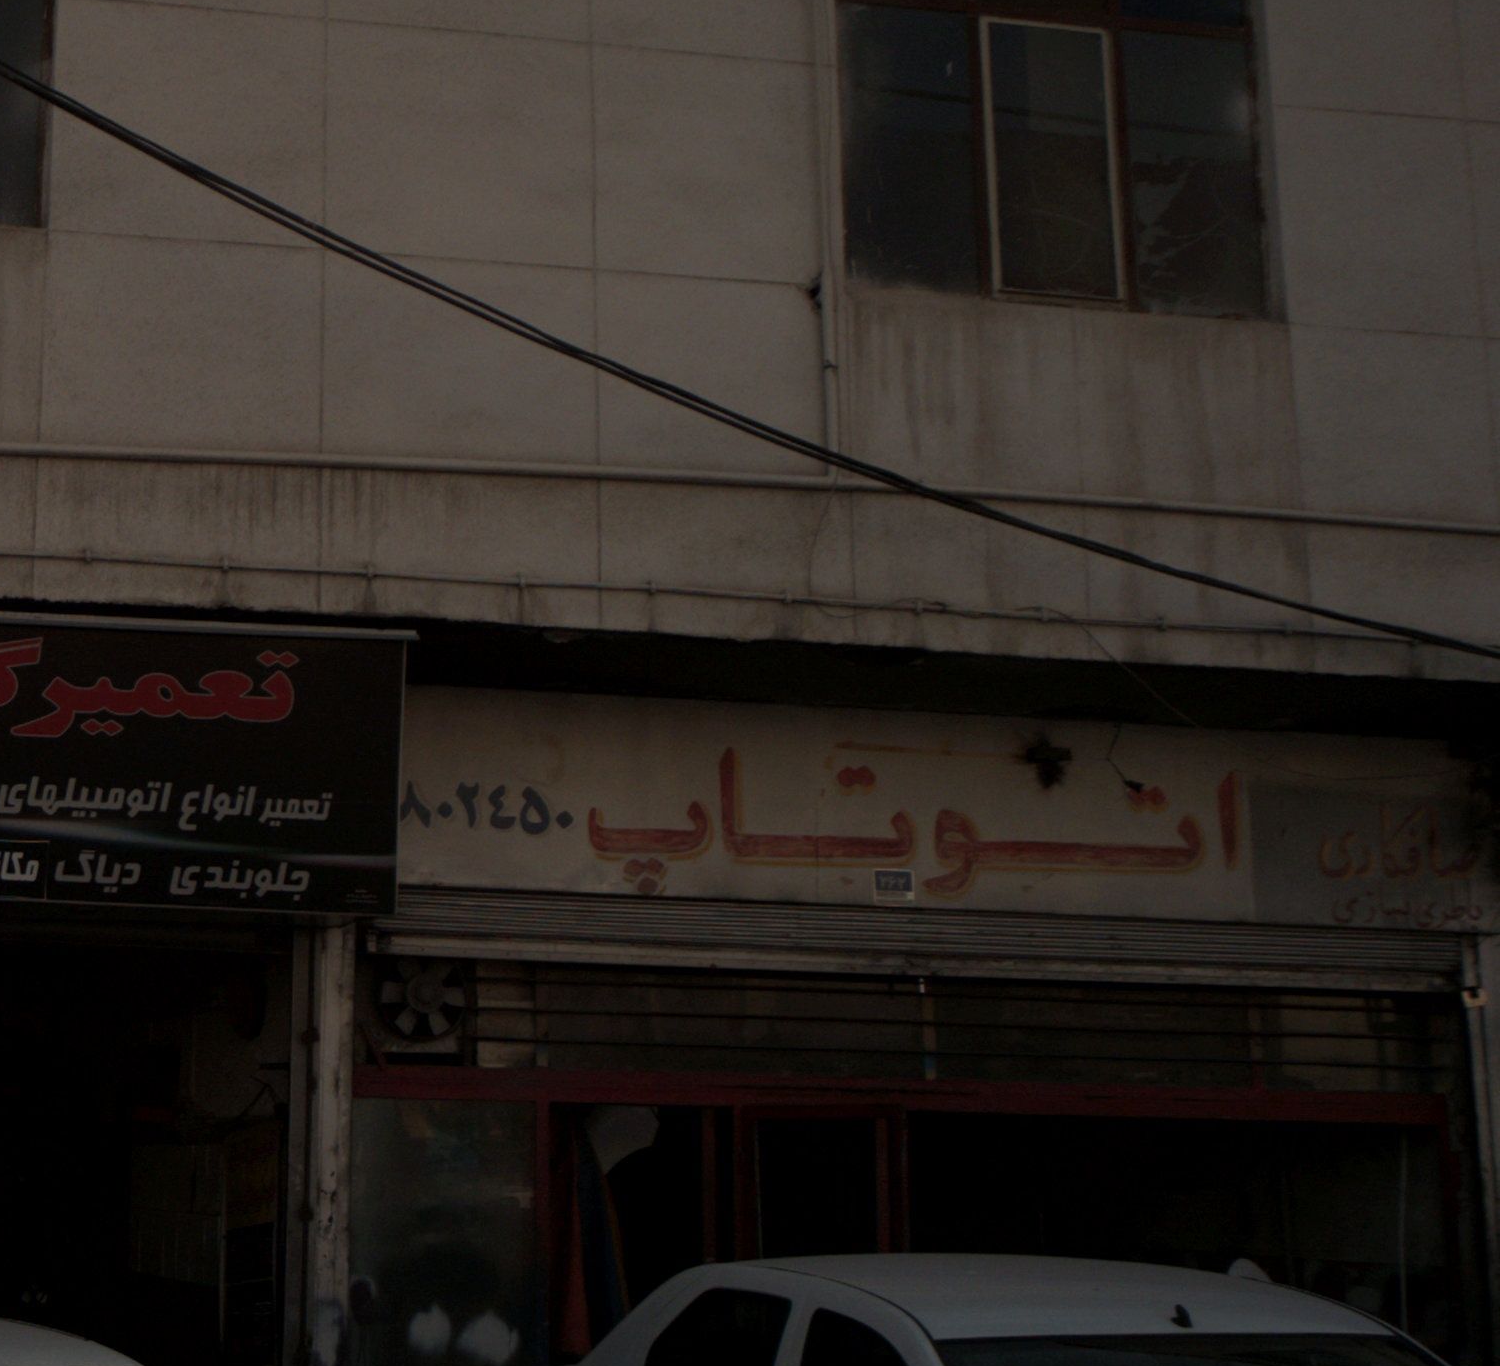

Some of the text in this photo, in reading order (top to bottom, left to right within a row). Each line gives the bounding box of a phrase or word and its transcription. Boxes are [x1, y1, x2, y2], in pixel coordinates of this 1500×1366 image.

[177, 785, 255, 832] انواع
[258, 792, 334, 829] تعمیر
[54, 847, 142, 891] دیاگ
[168, 853, 311, 902] جلوبندی
